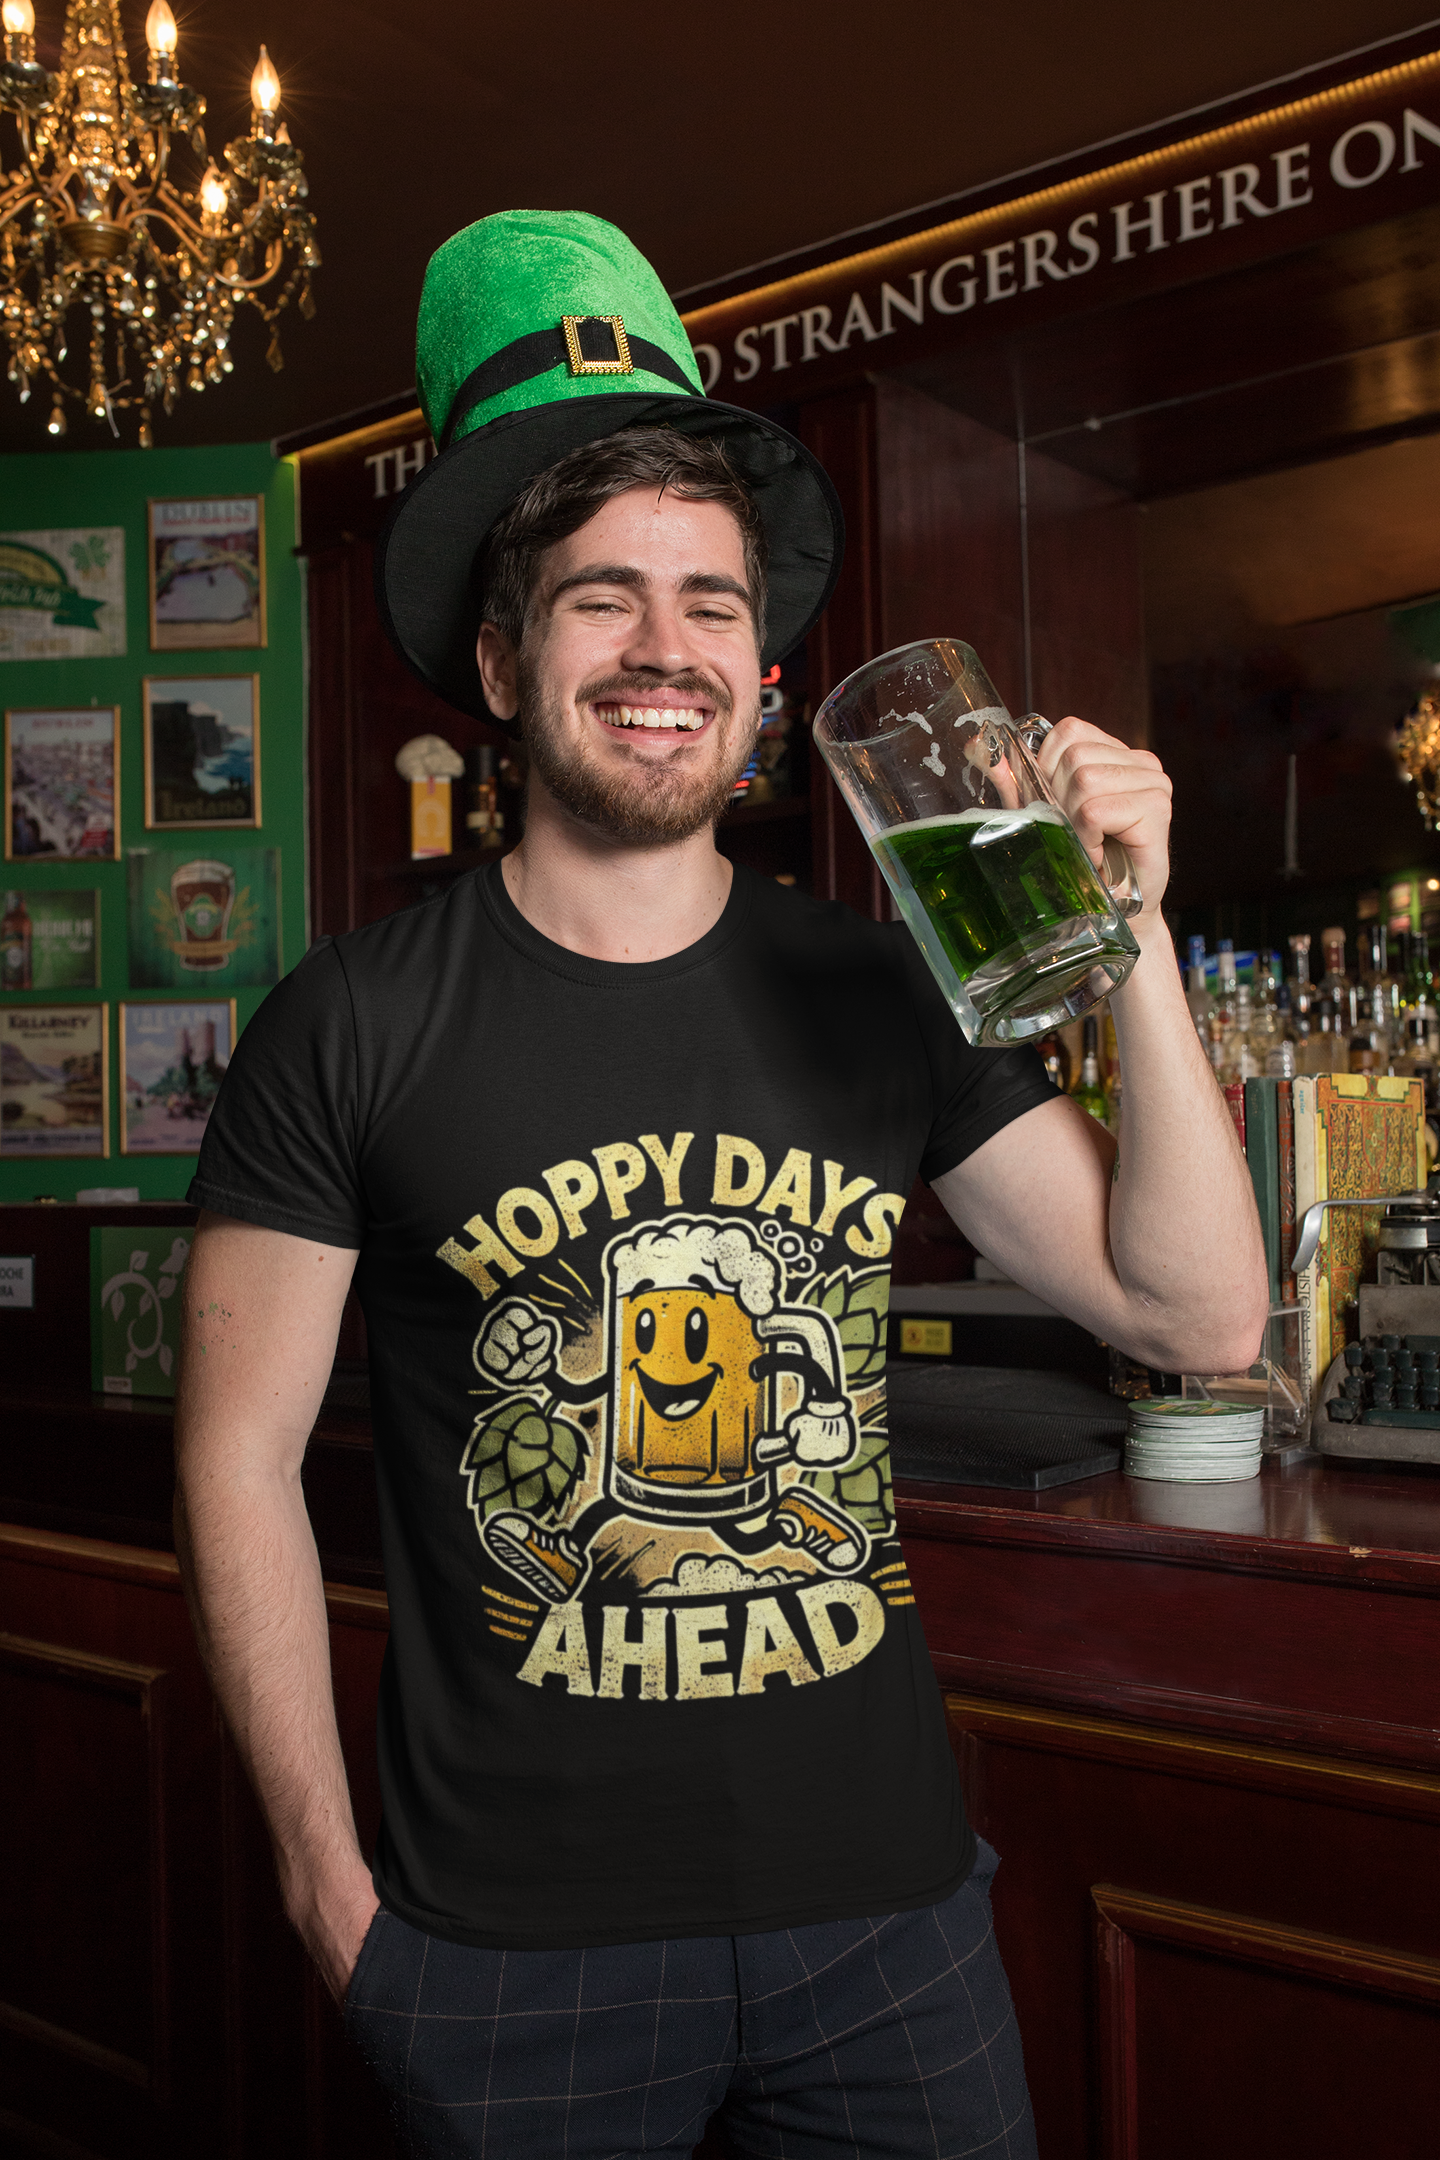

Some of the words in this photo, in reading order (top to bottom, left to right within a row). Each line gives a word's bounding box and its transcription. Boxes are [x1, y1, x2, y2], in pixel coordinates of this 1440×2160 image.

[364, 436, 438, 498] TH
[733, 213, 1099, 383] STRANGERS
[1110, 143, 1313, 263] HERE
[436, 1132, 694, 1300] HOPPY
[711, 1134, 906, 1258] DAYS
[516, 1579, 886, 1700] AHEAD
